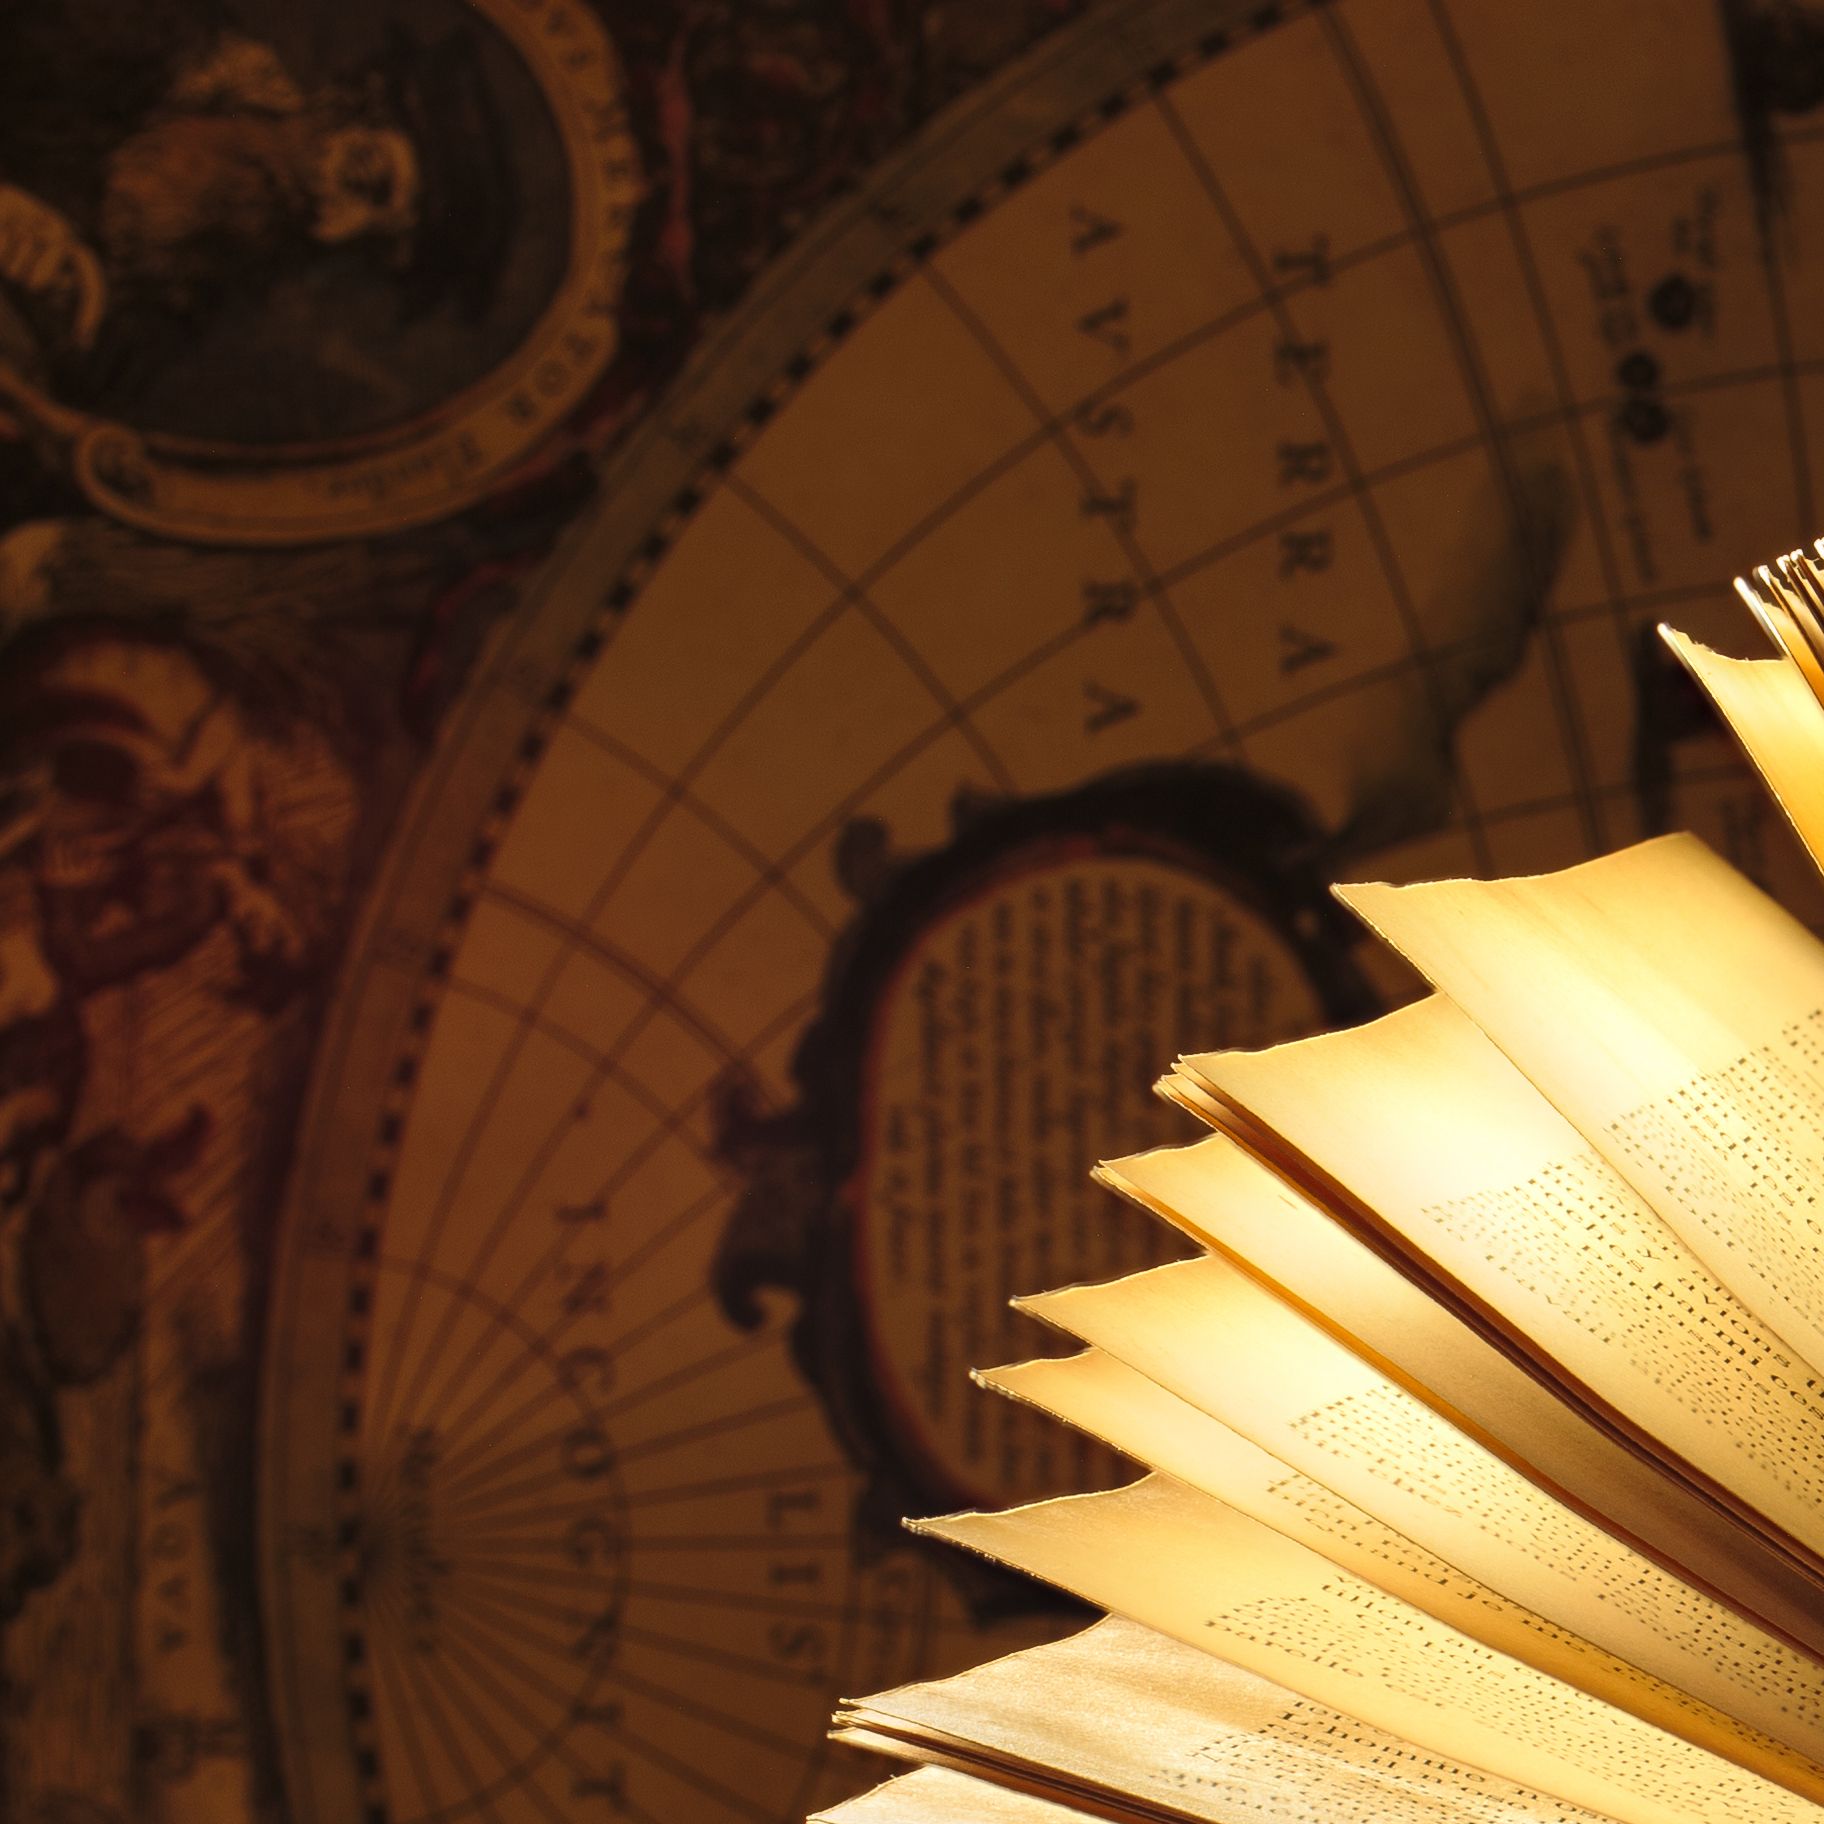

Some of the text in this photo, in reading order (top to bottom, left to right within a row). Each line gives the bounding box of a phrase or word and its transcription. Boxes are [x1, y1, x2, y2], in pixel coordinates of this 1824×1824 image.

[1273, 230, 1340, 680] TERRA
[1653, 1282, 1762, 1365] parmi
[1678, 1278, 1790, 1367] avions
